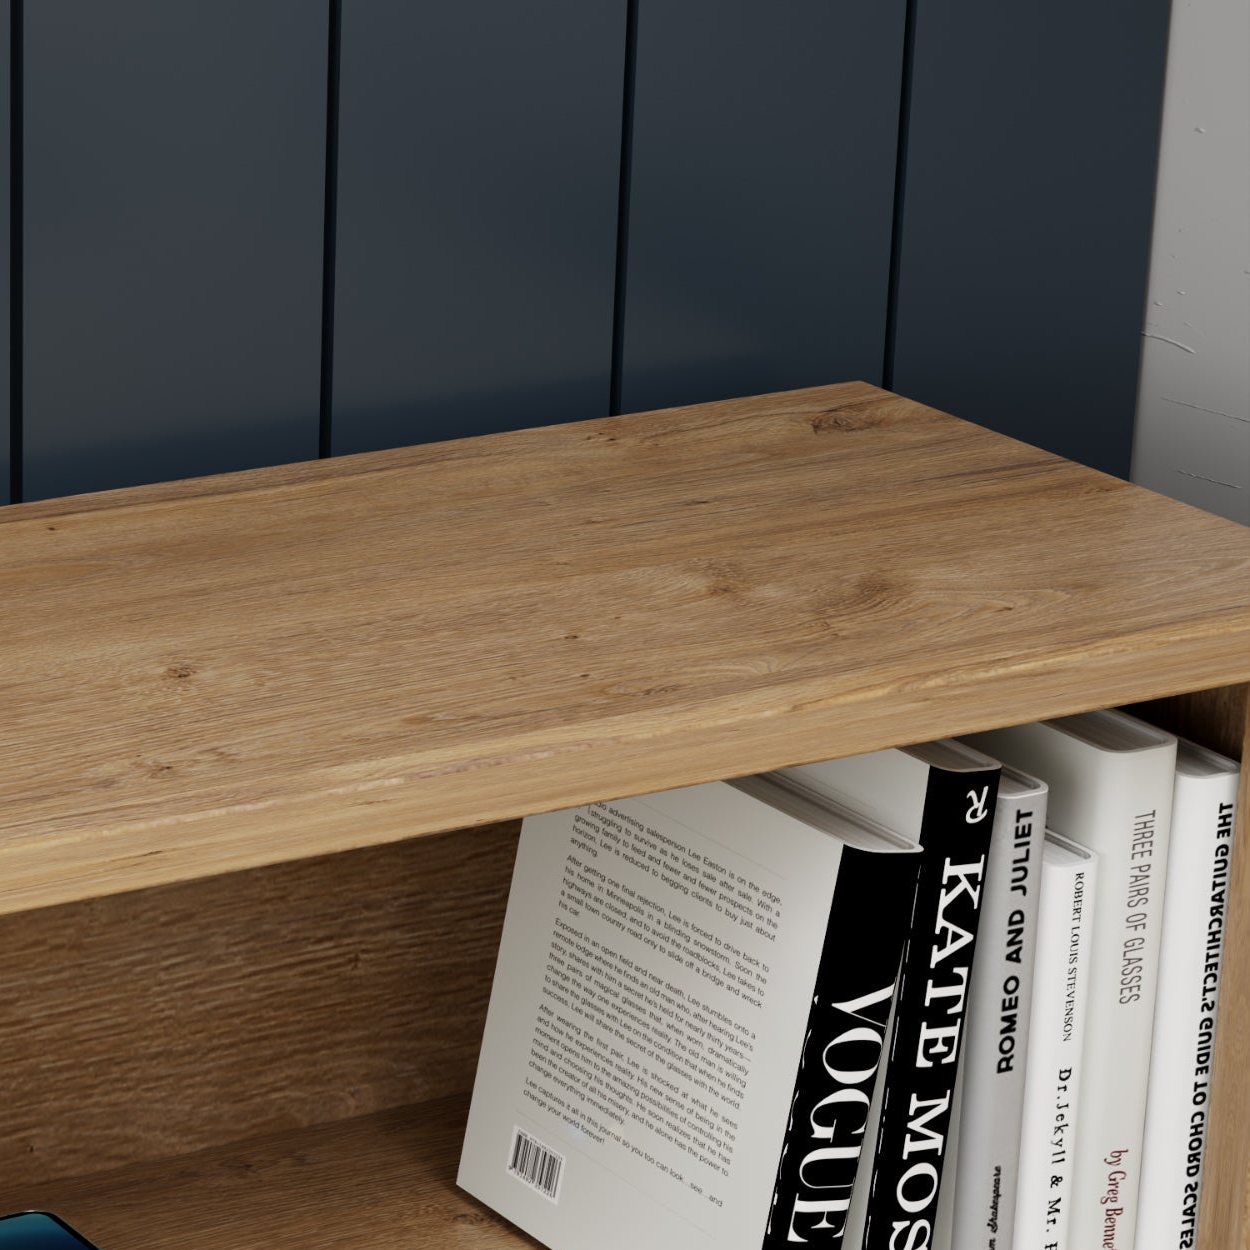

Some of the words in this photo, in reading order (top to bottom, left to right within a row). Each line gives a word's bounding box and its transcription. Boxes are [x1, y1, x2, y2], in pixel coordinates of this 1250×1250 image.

[1010, 808, 1033, 897] JULIET
[1131, 809, 1157, 860] THREE
[1072, 872, 1085, 923] ROBERT
[1126, 863, 1152, 908] PAIRS
[1005, 909, 1025, 964] AND
[1069, 926, 1082, 965] LOUIS
[1125, 912, 1148, 932] OF
[915, 854, 985, 1068] KATE
[1119, 937, 1145, 1005] GLASSES
[997, 975, 1020, 1074] ROMEO
[1063, 967, 1078, 1042] STEVENSON
[787, 977, 897, 1243] VOGUE
[1050, 1175, 1063, 1188] &
[1103, 1149, 1129, 1166] by
[1100, 1170, 1127, 1205] Greg
[1046, 1197, 1062, 1233] Mr.
